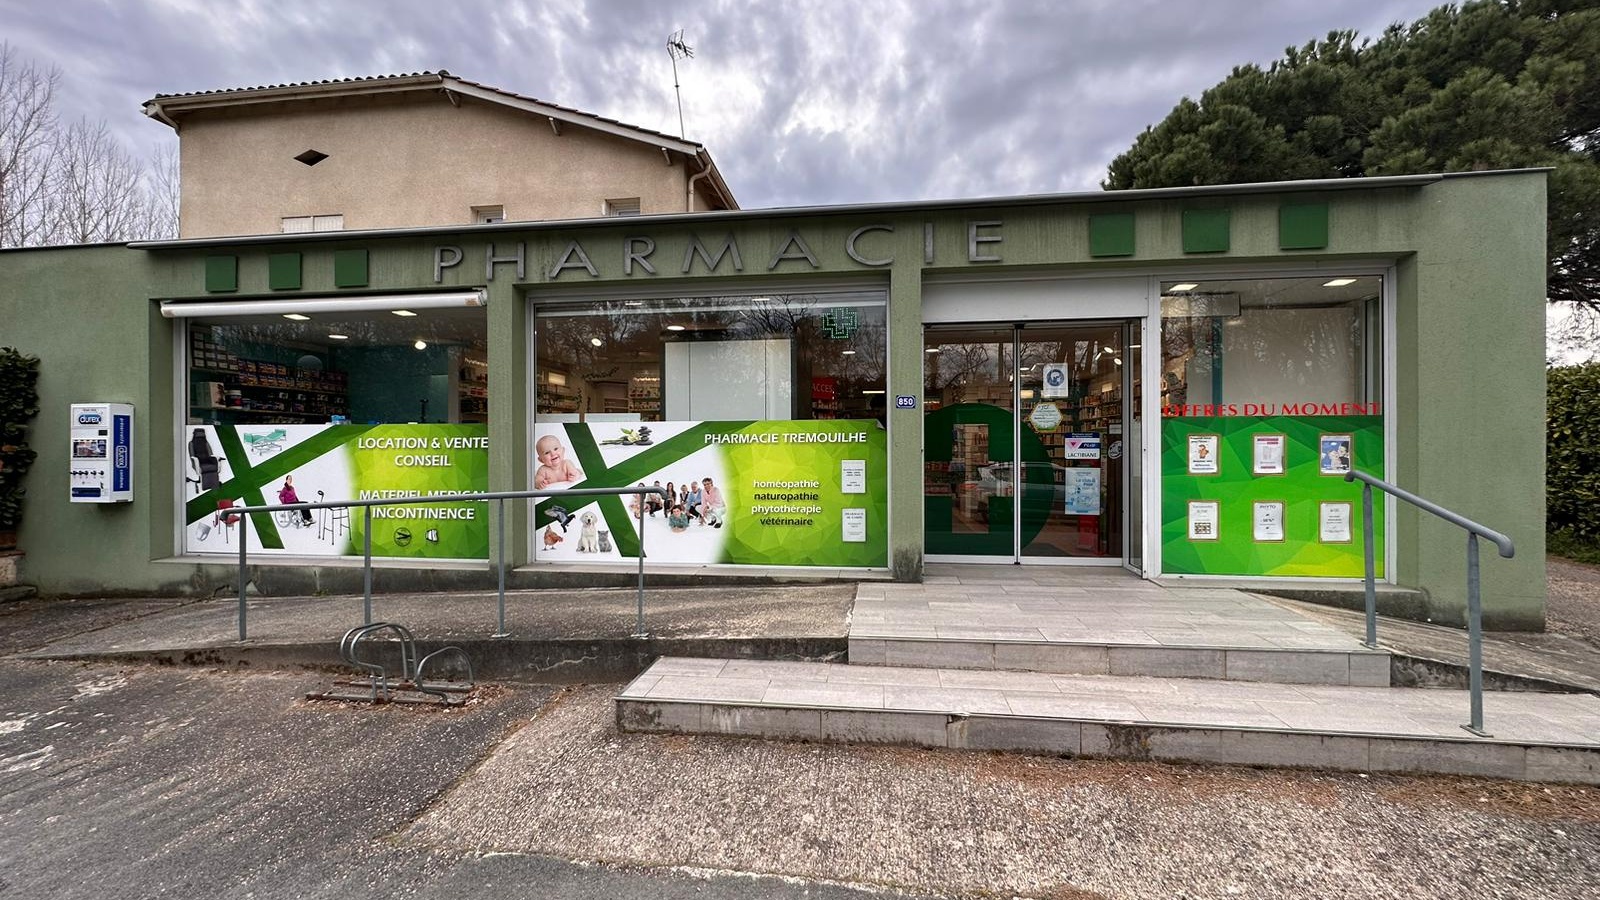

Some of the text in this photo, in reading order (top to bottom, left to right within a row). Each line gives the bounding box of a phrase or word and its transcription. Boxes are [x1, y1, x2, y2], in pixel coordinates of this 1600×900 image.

[434, 219, 1003, 282] PHARMACIE
[898, 397, 914, 406] 850
[1163, 402, 1381, 417] OFFRES DU MOMENT
[80, 414, 101, 424] durex
[358, 437, 489, 449] LOCATION & VENTE
[704, 432, 867, 444] PHARMACIE TREMOUILHE
[118, 447, 127, 466] durex
[394, 455, 452, 466] CONSEIL
[753, 479, 820, 490] homéopathie
[360, 490, 422, 500] MATERIEL
[754, 492, 819, 502] naturopathie
[372, 507, 475, 519] INCONTINENCE
[751, 504, 822, 515] phytothérapie
[760, 516, 814, 526] vétérinaire
